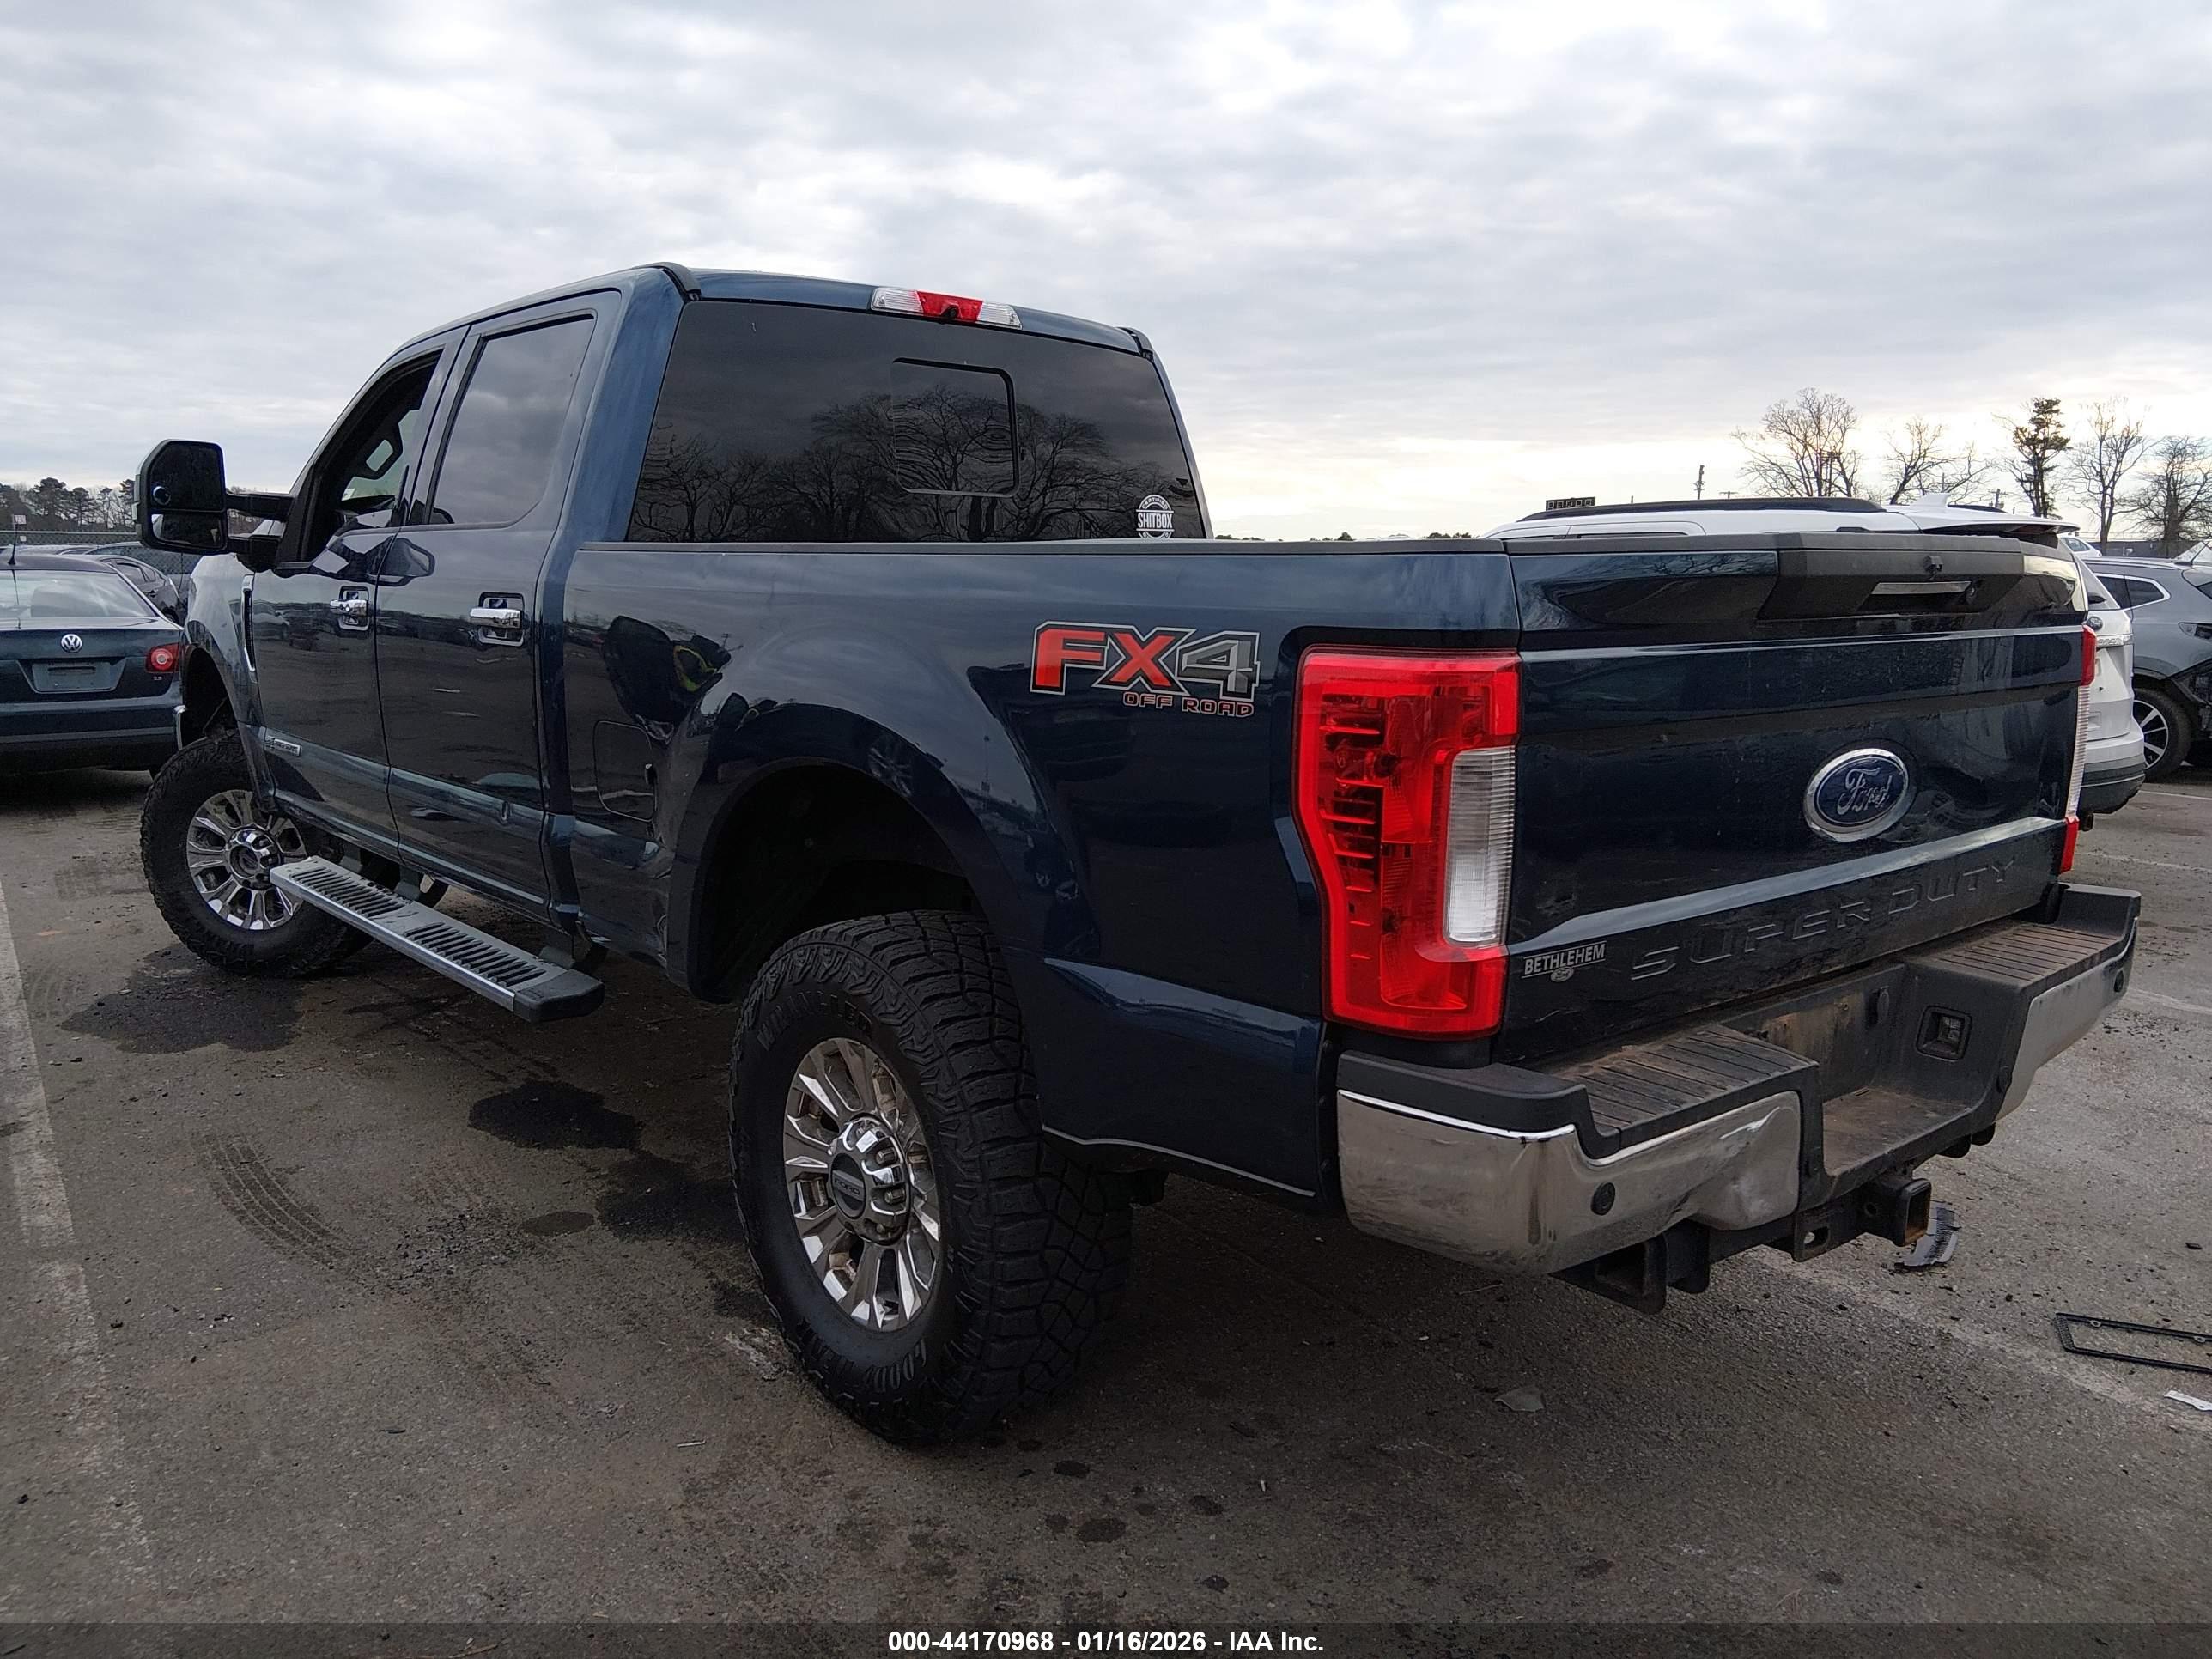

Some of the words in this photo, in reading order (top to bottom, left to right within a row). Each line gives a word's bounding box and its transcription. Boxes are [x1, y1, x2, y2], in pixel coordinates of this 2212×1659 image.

[1138, 513, 1173, 529] SHITBOX
[1030, 621, 1260, 702] FX4
[1122, 691, 1173, 708] OFF
[1182, 697, 1255, 717] ROAD
[1837, 767, 1893, 815] Ford
[1631, 901, 1872, 981] SUPER
[1888, 859, 2015, 915] DUTY
[1524, 943, 1606, 975] BETHLEHEM
[834, 1177, 860, 1195] FORD
